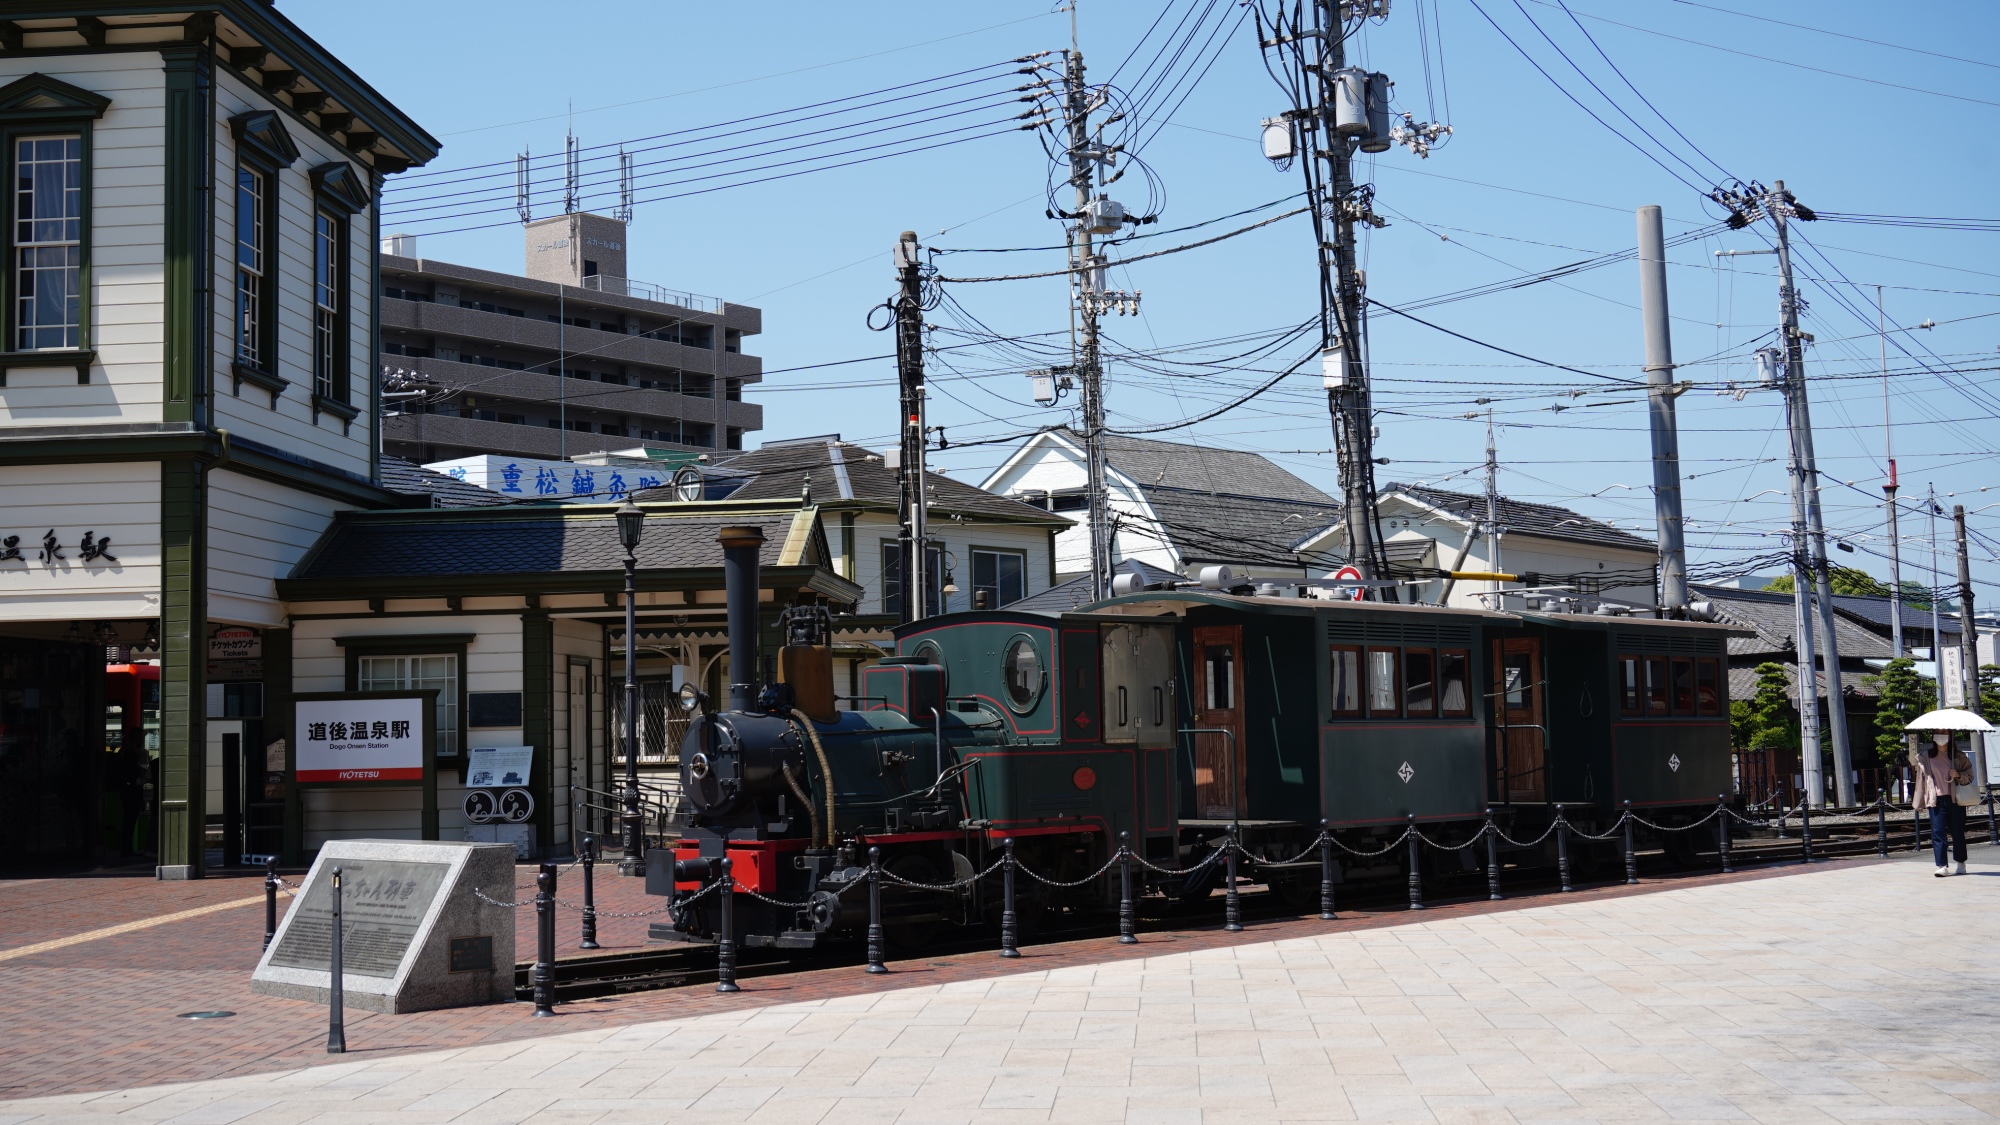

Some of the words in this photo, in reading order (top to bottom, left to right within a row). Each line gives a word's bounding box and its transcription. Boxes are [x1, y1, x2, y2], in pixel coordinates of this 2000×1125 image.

[219, 631, 252, 639] IYOTETSU
[211, 640, 259, 649] チケットカウンター
[308, 720, 410, 741] 道後温泉駅
[339, 770, 379, 779] IYOTETSU
